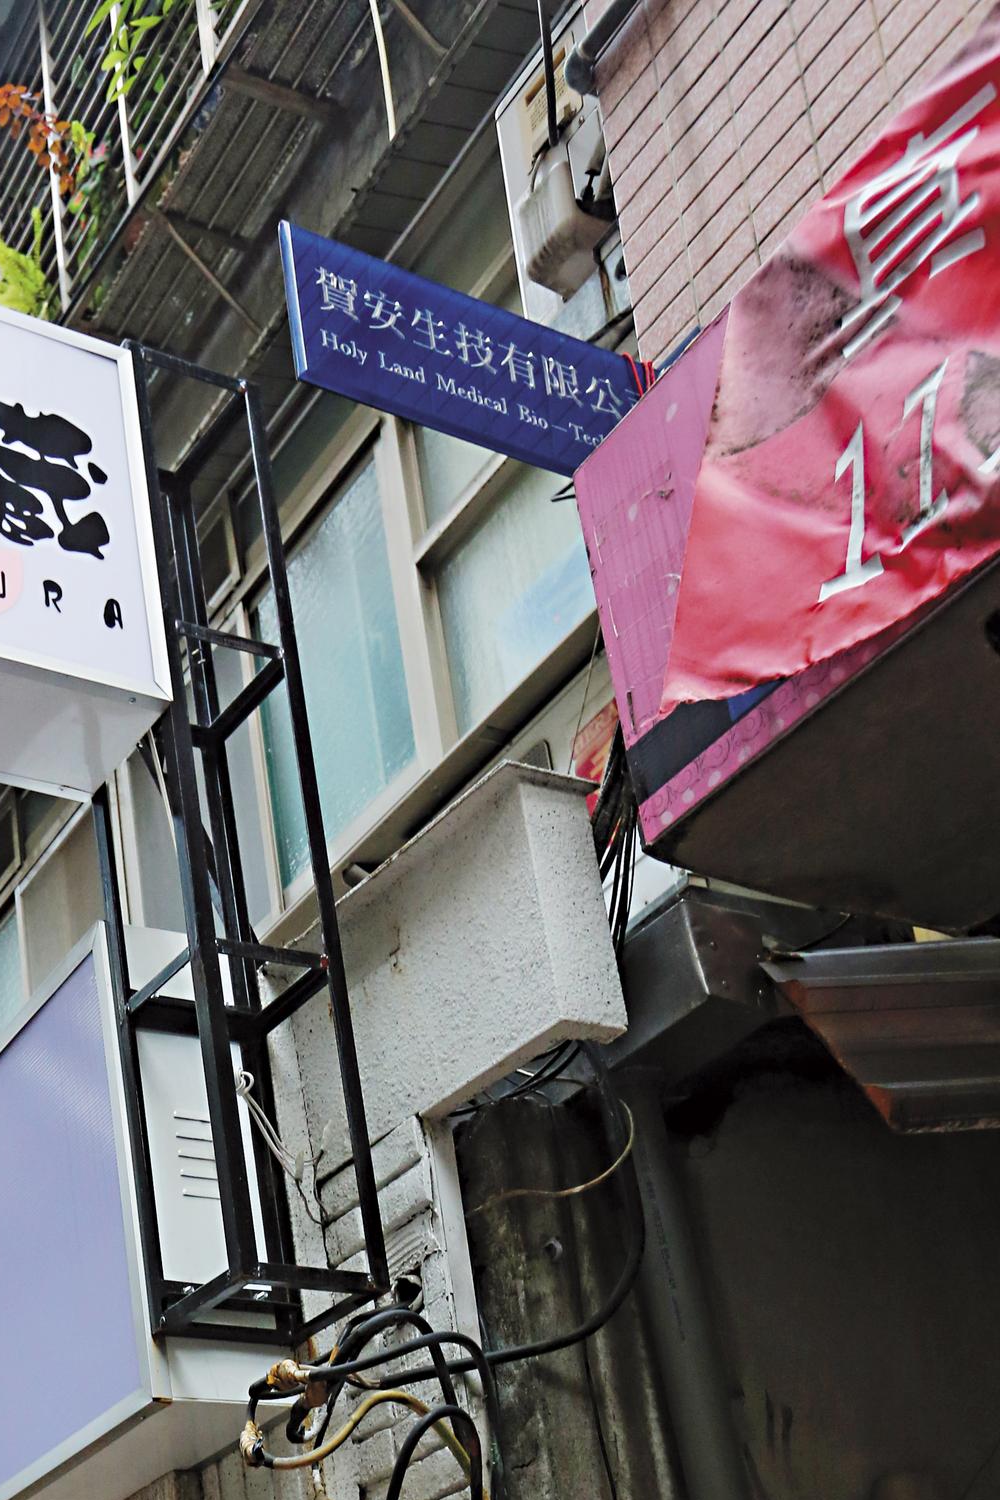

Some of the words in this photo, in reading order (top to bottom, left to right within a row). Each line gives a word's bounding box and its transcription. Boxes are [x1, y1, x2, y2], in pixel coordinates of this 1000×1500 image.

[319, 329, 369, 366] Holy
[378, 350, 427, 385] Land
[435, 373, 509, 416] Medical
